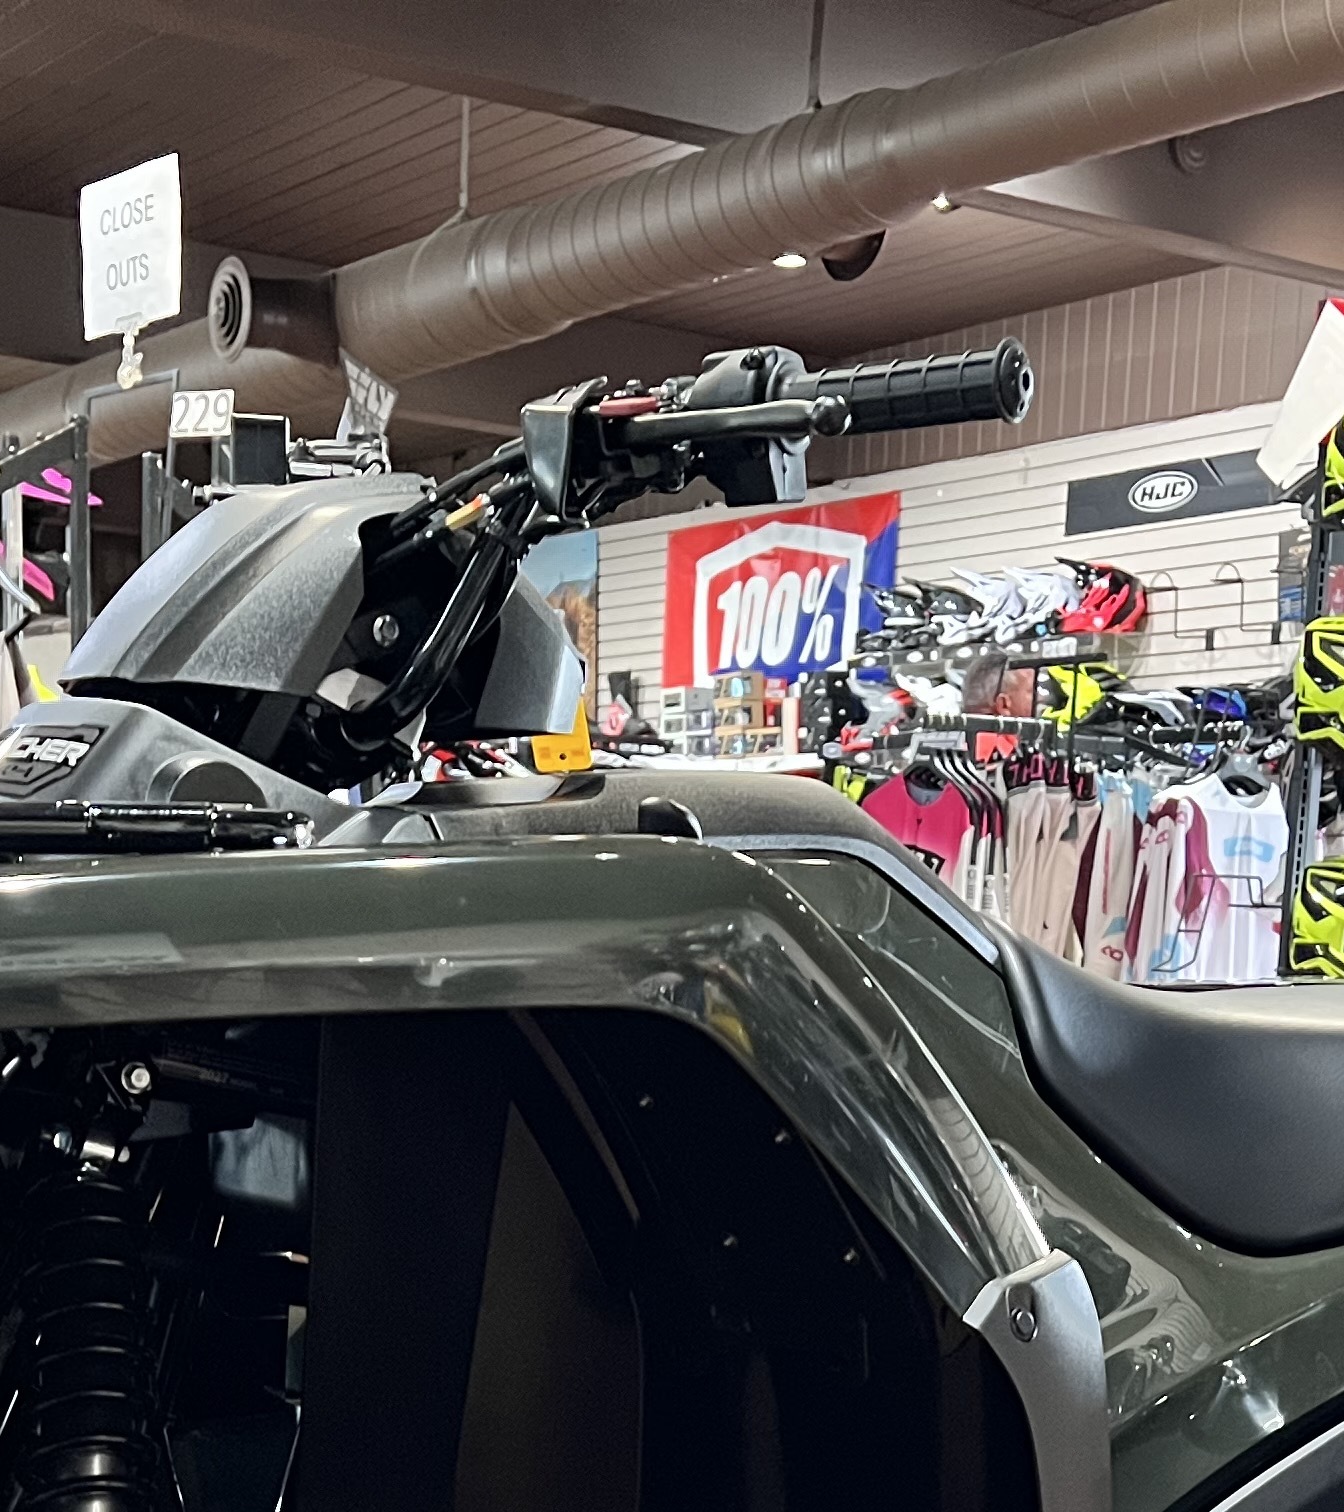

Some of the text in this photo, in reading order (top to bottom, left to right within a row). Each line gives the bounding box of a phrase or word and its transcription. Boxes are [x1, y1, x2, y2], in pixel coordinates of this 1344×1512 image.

[99, 193, 155, 236] CLOSE
[106, 253, 150, 291] OUTS
[173, 391, 232, 434] 229
[1140, 480, 1186, 502] HJC
[716, 564, 835, 669] 100%
